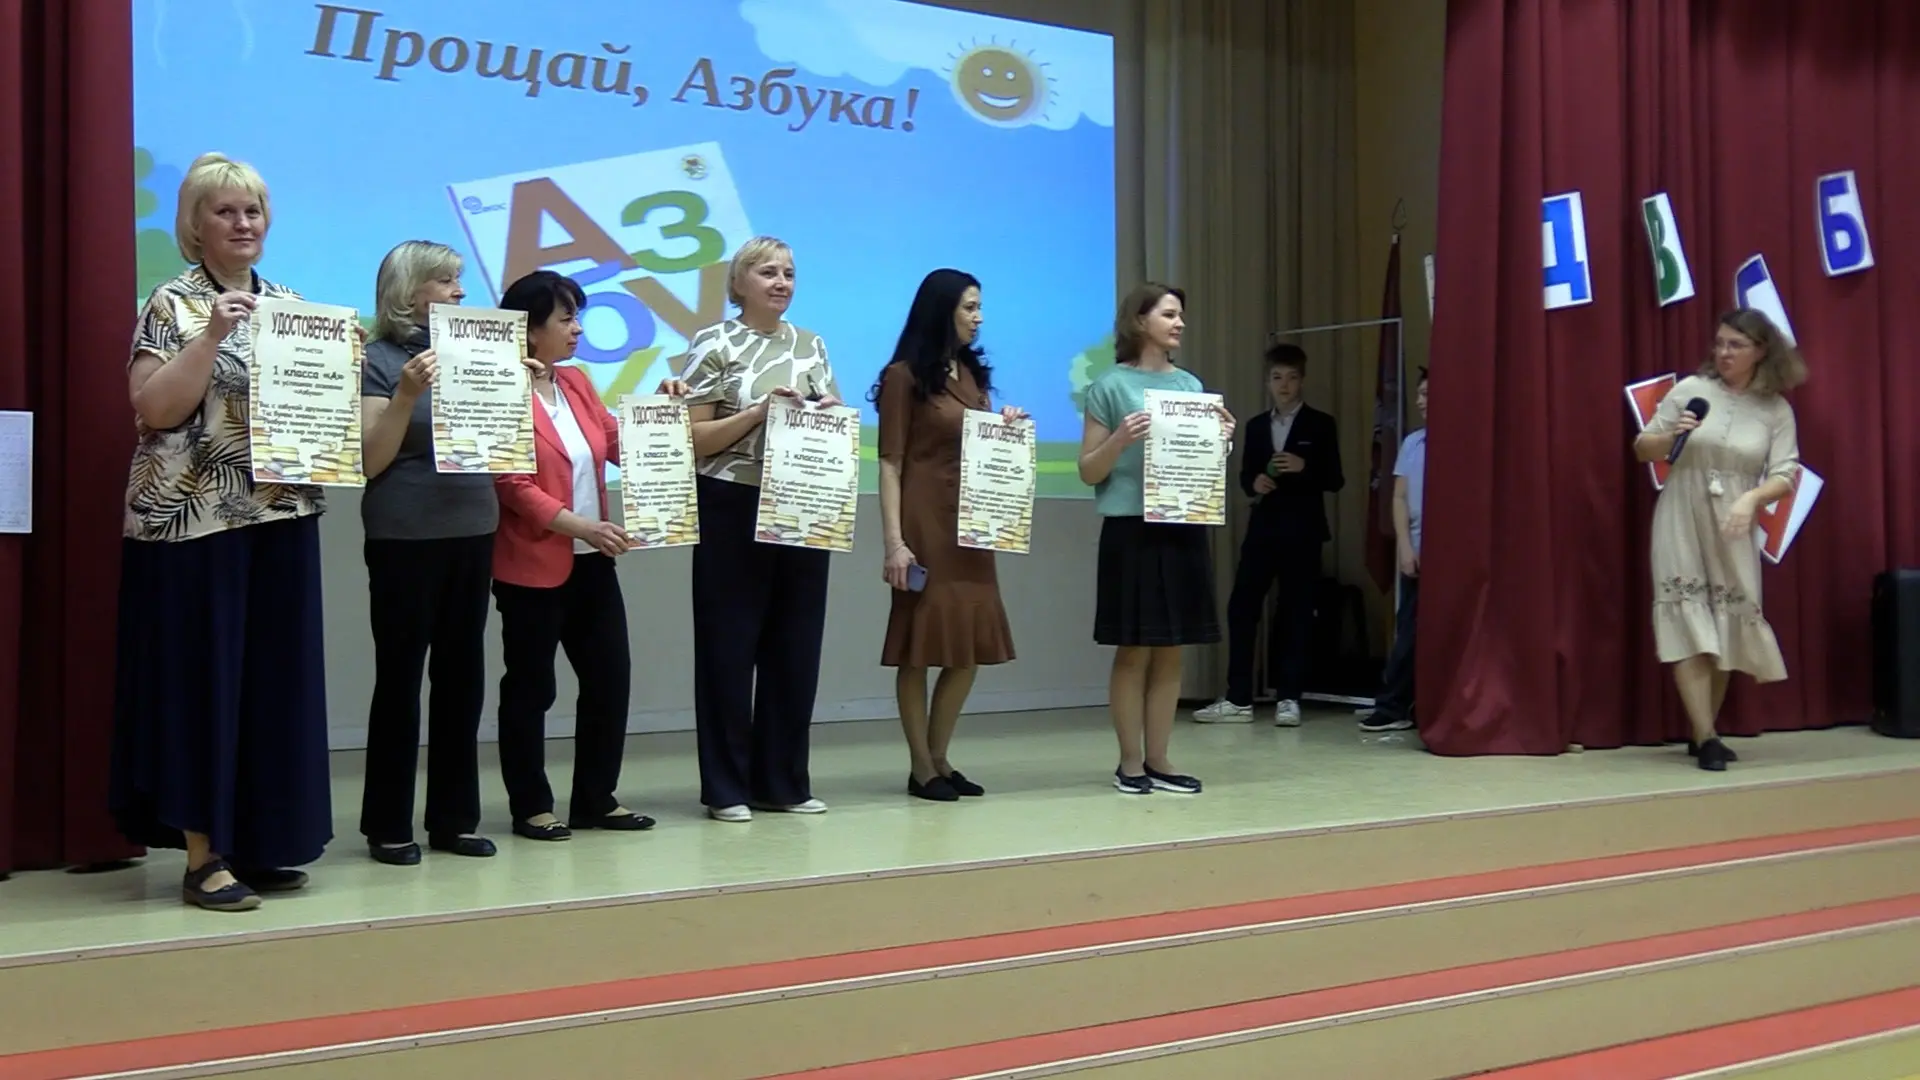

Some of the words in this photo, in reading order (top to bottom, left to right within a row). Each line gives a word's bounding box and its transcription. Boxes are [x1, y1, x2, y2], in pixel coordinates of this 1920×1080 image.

[304, 4, 649, 108] Прощай,
[671, 57, 919, 132] Азбука!
[1819, 175, 1866, 271] Б
[1644, 198, 1682, 301] В
[271, 311, 346, 342] УДОСТОВЕРЕНИЕ
[448, 317, 515, 343] УДОСТОВЕРЕНИЕ
[273, 365, 279, 375] 1
[284, 368, 319, 379] класса
[323, 371, 345, 380] «А»
[453, 366, 458, 375] 1
[463, 368, 495, 377] класса
[784, 408, 849, 436] УДОСТОВЕРЕНИЕ
[636, 450, 640, 459] 1
[1162, 438, 1167, 446] 1
[785, 450, 790, 458] 1
[793, 453, 825, 463] класса
